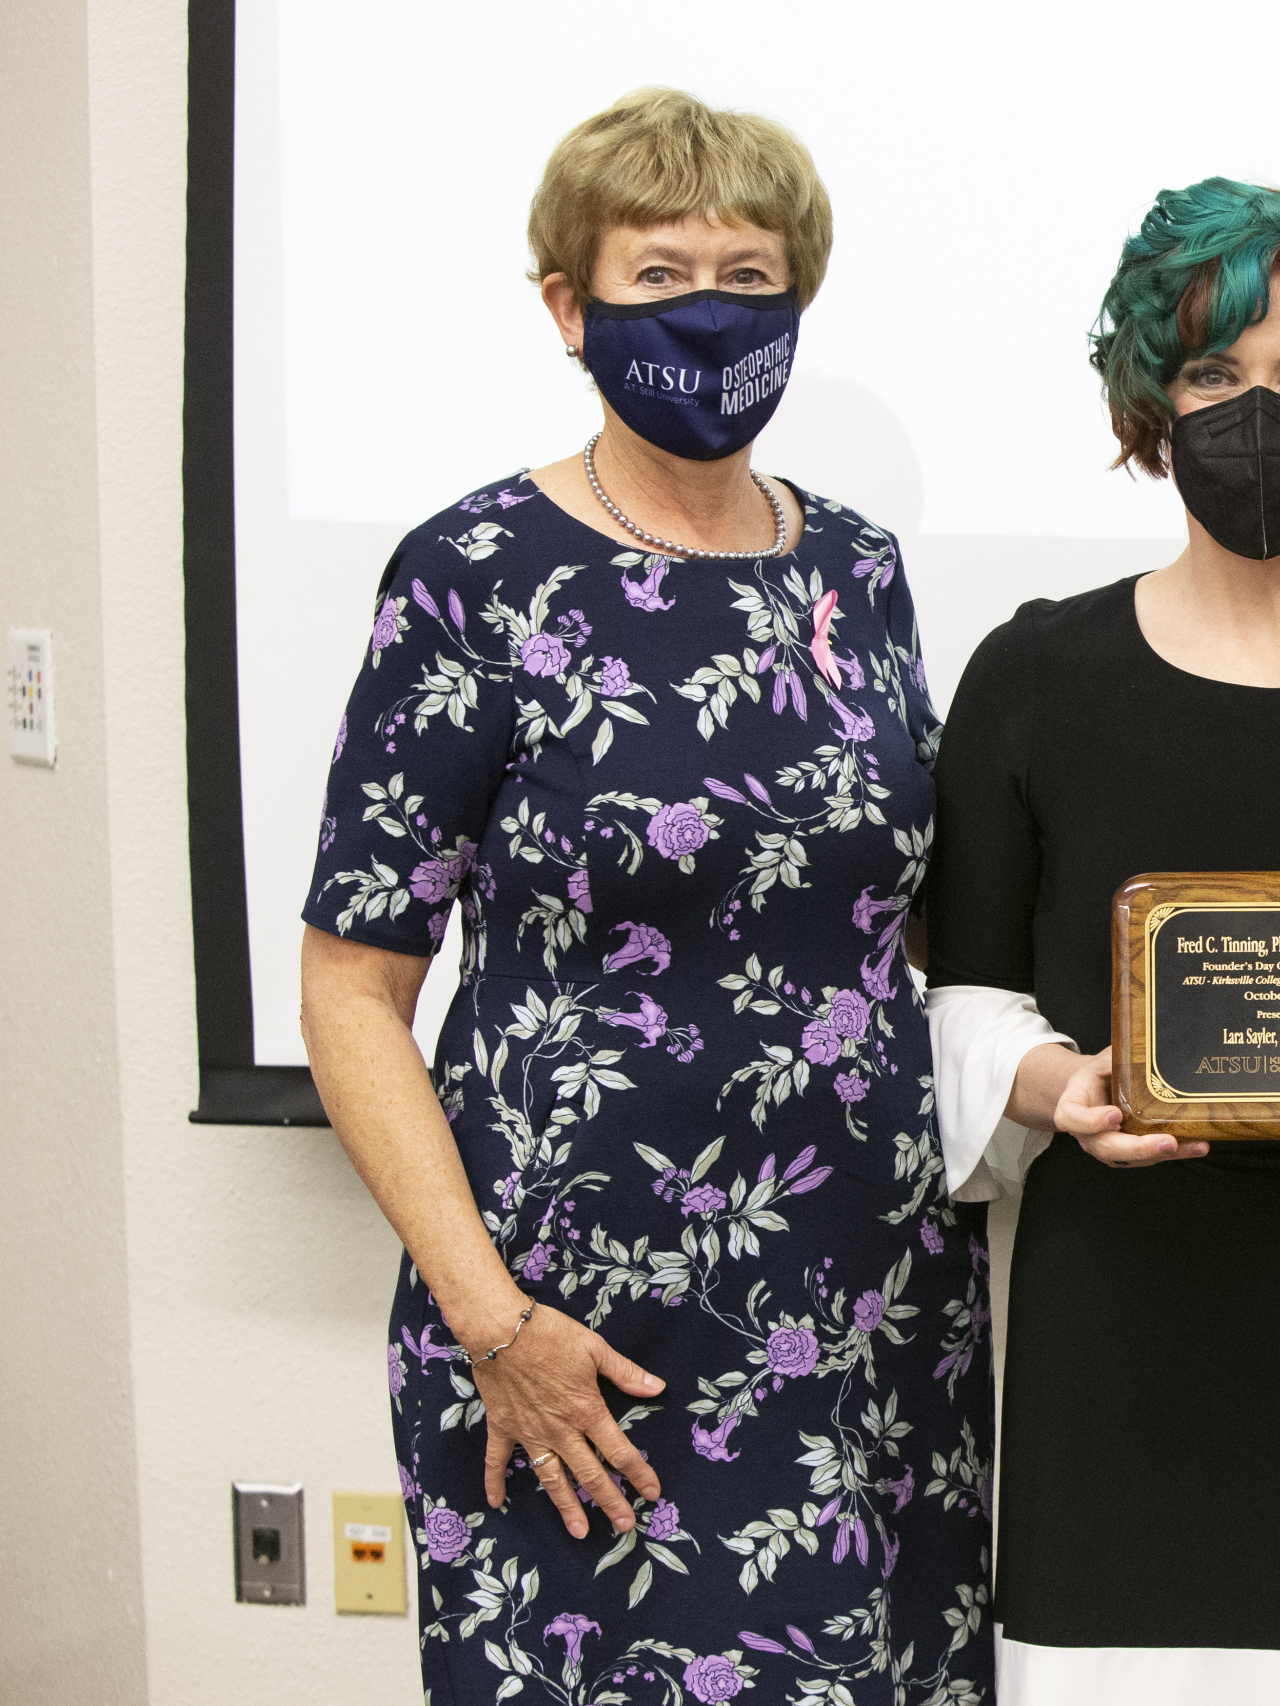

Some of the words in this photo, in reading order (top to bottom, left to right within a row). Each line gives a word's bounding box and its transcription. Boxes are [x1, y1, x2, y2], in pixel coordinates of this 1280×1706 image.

[722, 332, 790, 391] OSTEOPATHIC
[625, 359, 702, 394] ATSU
[720, 358, 789, 415] MEDICINE
[624, 382, 637, 394] A.T.
[639, 386, 655, 398] Still
[656, 390, 700, 407] University
[1177, 935, 1203, 953] Fred
[1205, 936, 1218, 953] C.
[1221, 936, 1269, 957] Tinning,
[1202, 962, 1253, 971] Founder's
[1255, 962, 1274, 972] Day
[1182, 976, 1206, 985] ATSU
[1212, 975, 1254, 985] Kirksville
[1223, 1028, 1245, 1044] Lara
[1246, 1027, 1278, 1048] Sayler,
[1195, 1056, 1261, 1074] ATSU
